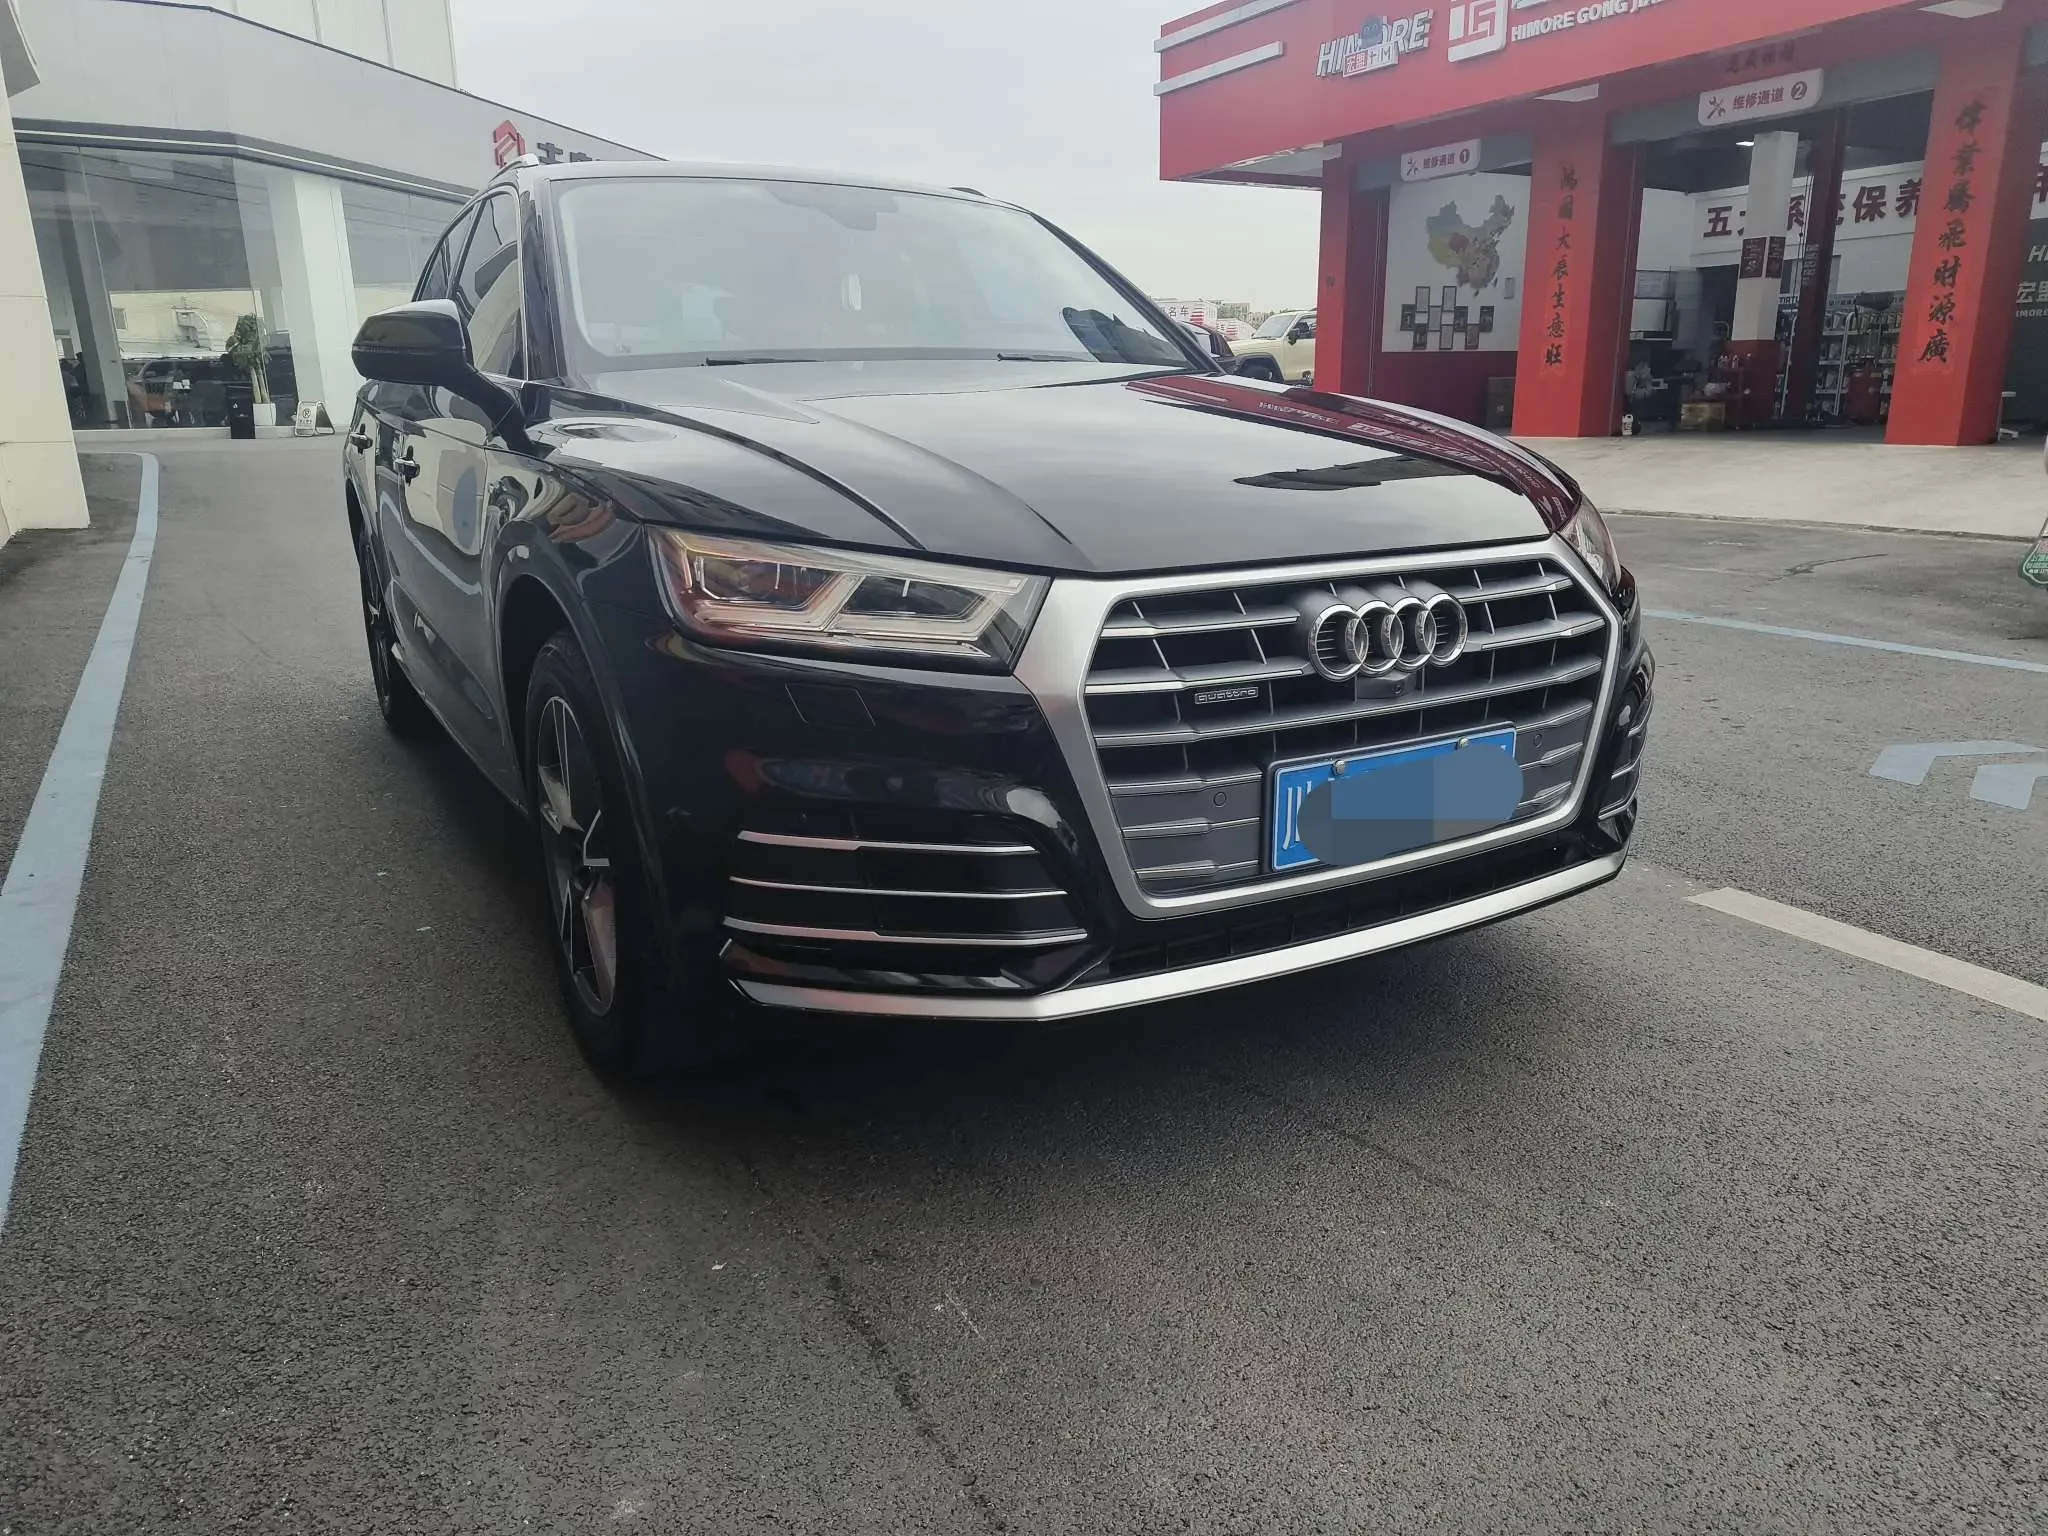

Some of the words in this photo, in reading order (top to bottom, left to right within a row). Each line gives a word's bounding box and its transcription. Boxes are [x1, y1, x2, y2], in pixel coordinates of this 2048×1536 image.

[1512, 11, 1576, 42] HIMORE
[1576, 0, 1629, 24] GONG
[1732, 86, 1785, 110] 维修通道
[1198, 688, 1257, 704] quattro
